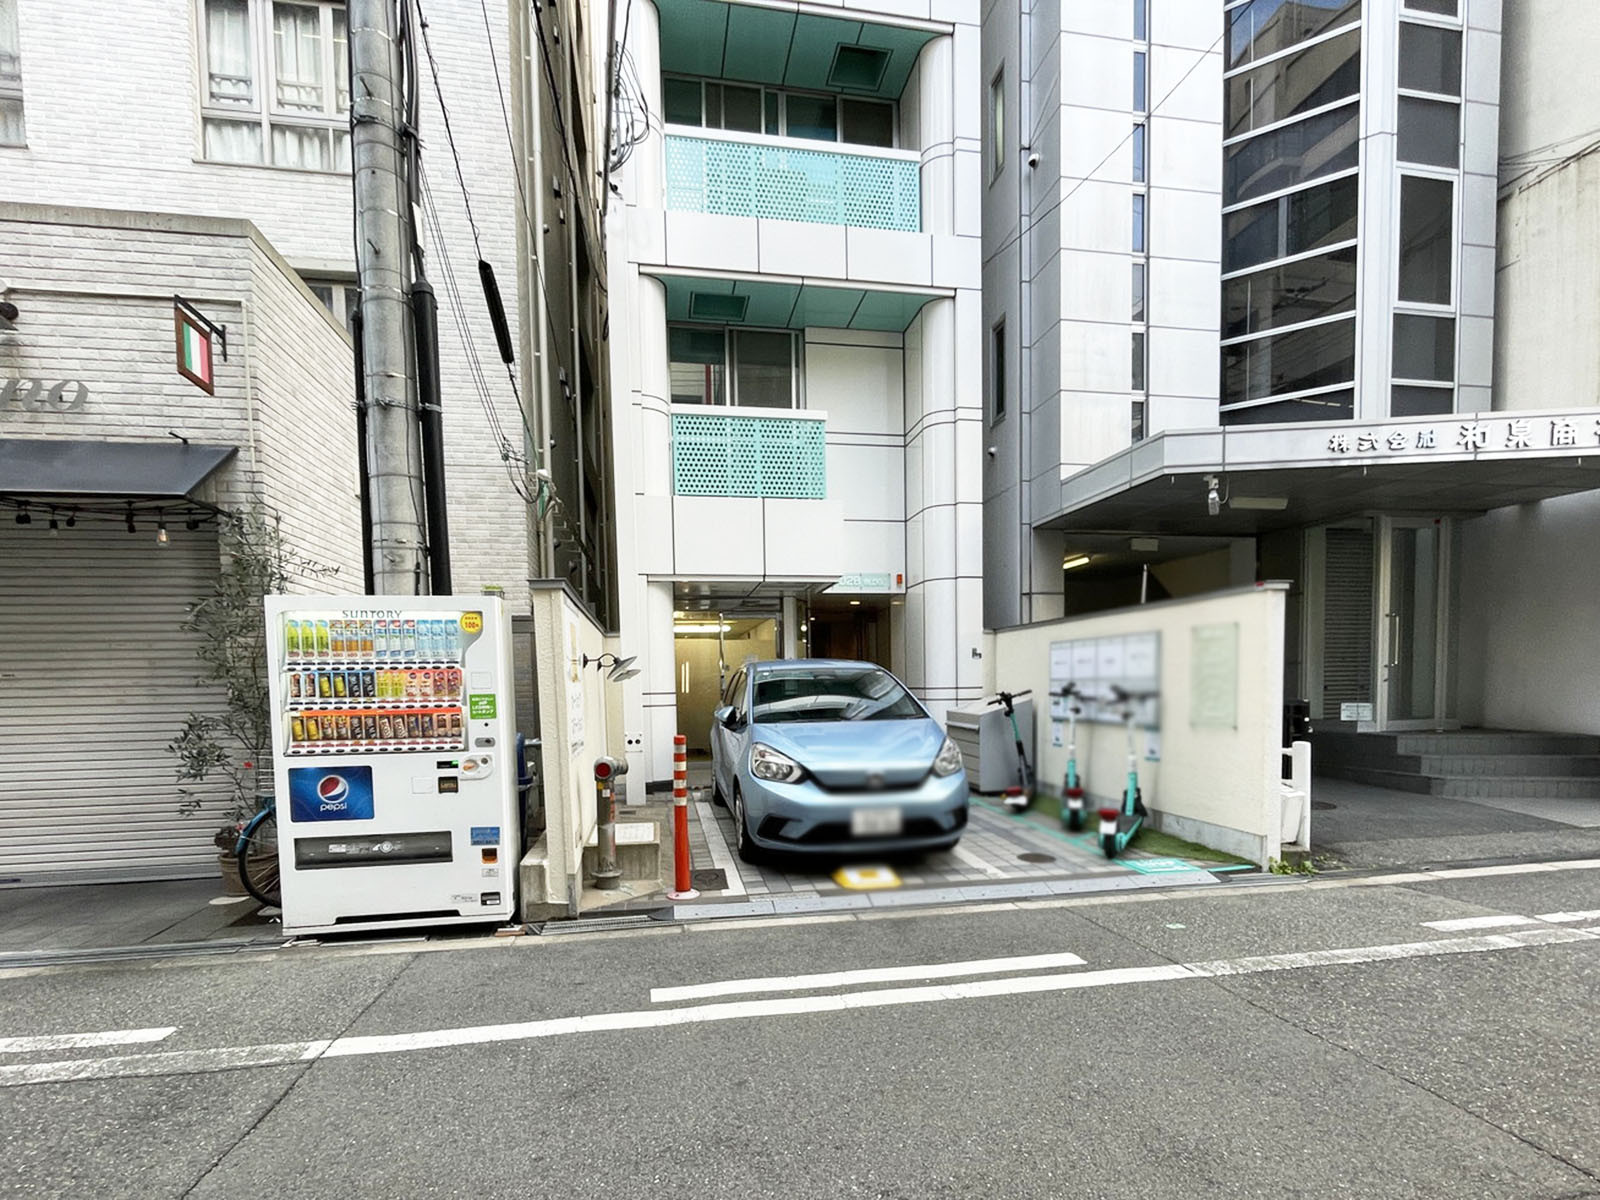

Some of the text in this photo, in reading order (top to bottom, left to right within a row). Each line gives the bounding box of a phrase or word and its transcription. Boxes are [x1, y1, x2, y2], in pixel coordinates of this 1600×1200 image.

[1457, 418, 1600, 450] 和泉商
[320, 802, 347, 812] pepsi
